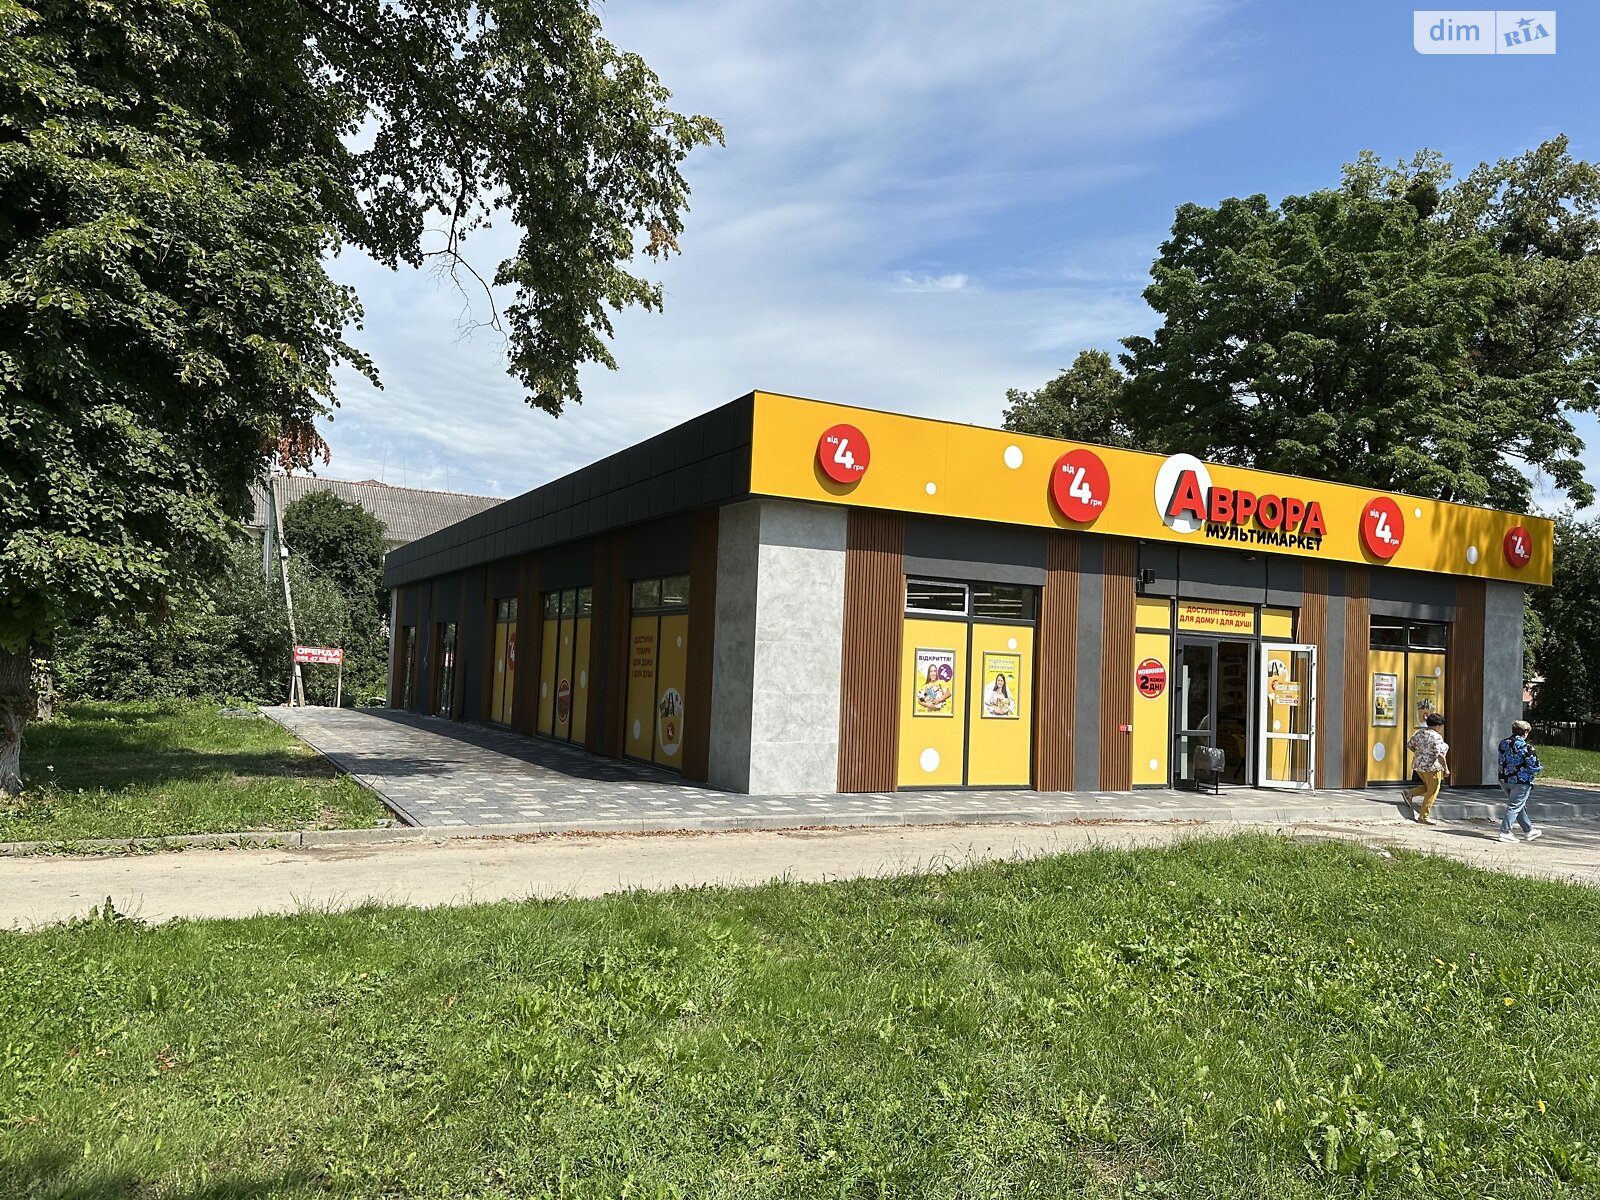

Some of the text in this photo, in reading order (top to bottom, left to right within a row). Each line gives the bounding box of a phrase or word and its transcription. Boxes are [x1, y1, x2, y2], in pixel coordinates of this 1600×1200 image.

[827, 435, 839, 445] від
[834, 439, 855, 469] 4
[853, 464, 865, 472] грн
[1062, 463, 1075, 475] від
[1069, 467, 1092, 505] 4
[1090, 499, 1103, 508] грн
[1166, 469, 1327, 536] АВРОРА
[1370, 509, 1379, 518] від
[1375, 512, 1392, 544] 4
[1206, 524, 1323, 552] МУЛЬТИМАРКЕТ
[1515, 537, 1525, 558] 4
[1187, 606, 1246, 618] ДОСТУПНІ ТОВАРИ
[1179, 615, 1194, 623] ДЛЯ
[1235, 620, 1252, 628] ДУШІ
[297, 648, 341, 657] ОРЕНДА
[940, 668, 948, 678] 4
[1140, 676, 1149, 690] 2
[1149, 683, 1162, 691] ДНІ
